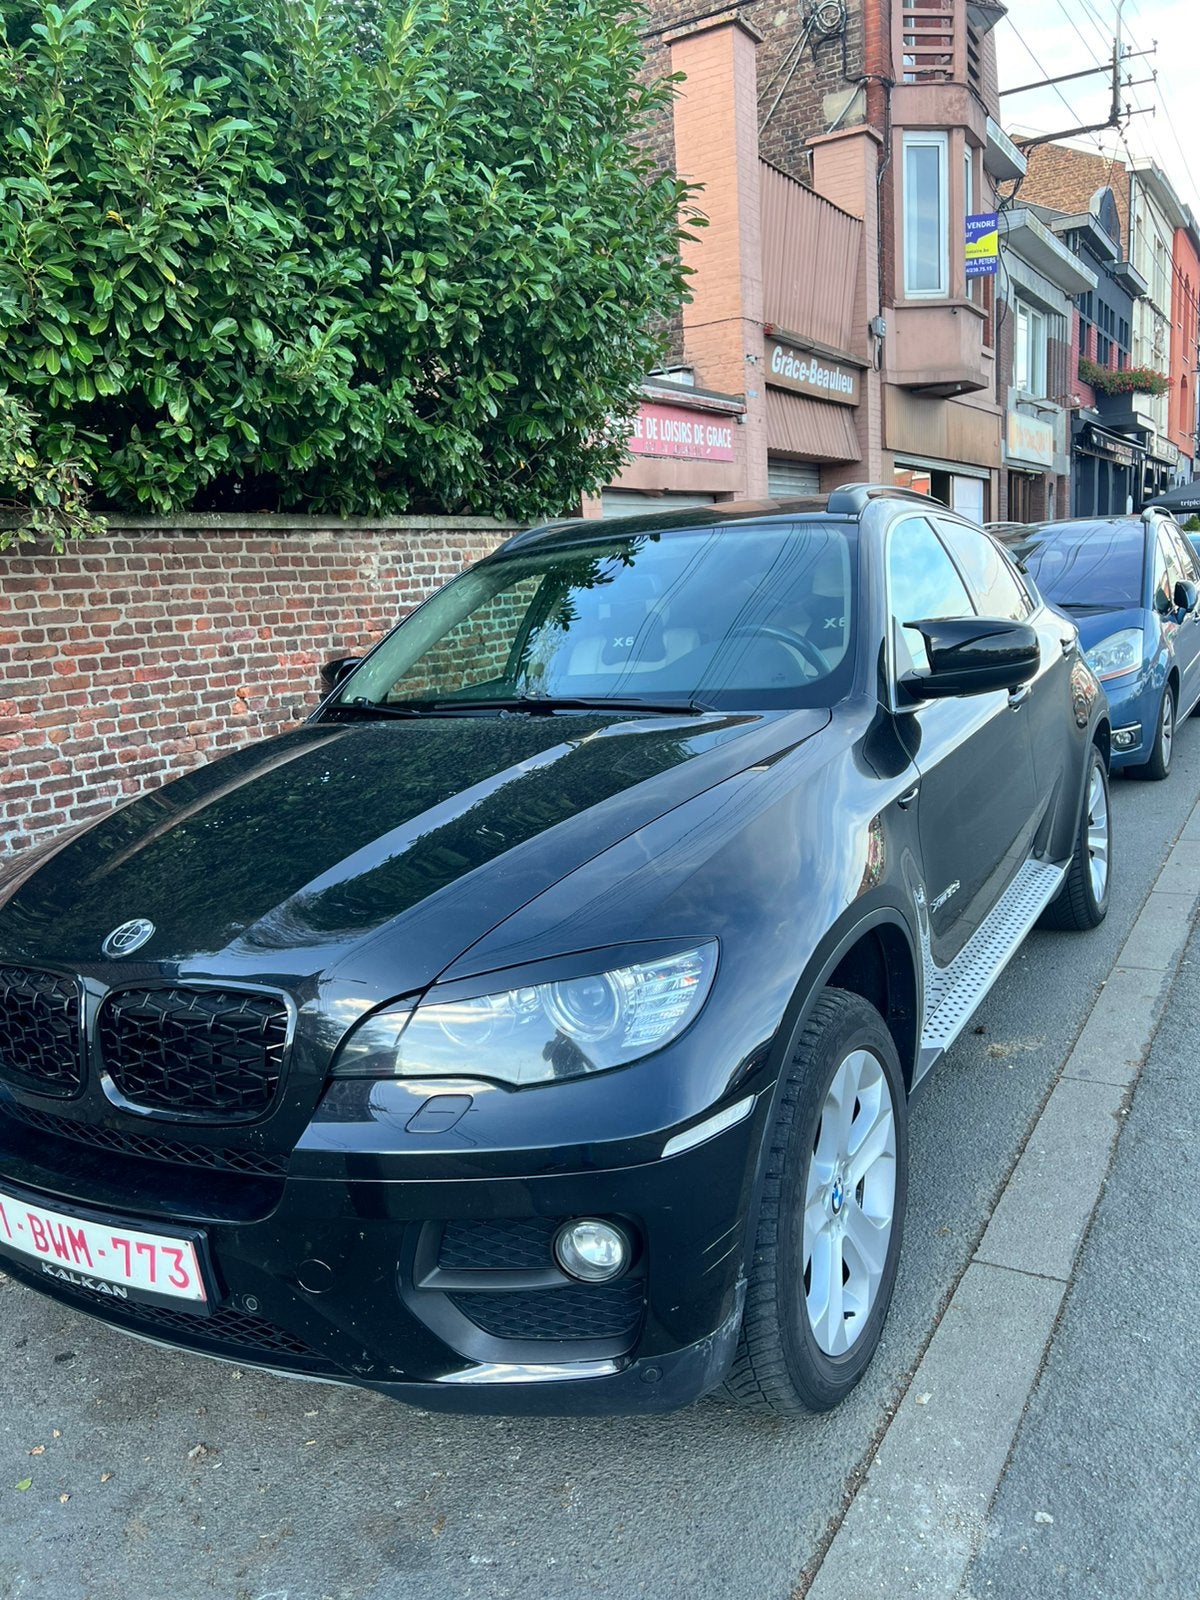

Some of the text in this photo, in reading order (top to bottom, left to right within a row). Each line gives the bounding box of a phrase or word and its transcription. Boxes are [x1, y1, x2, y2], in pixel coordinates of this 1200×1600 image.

[966, 220, 996, 229] VENDRE
[771, 345, 854, 394] Grâce-Beaulieu
[645, 417, 658, 440] DE
[660, 419, 692, 444] LOISIRS
[693, 423, 705, 446] DE
[706, 426, 732, 448] GRACE
[612, 636, 635, 648] X6
[0, 1201, 190, 1289] 1-BWM-773
[41, 1261, 128, 1298] KALKAN
